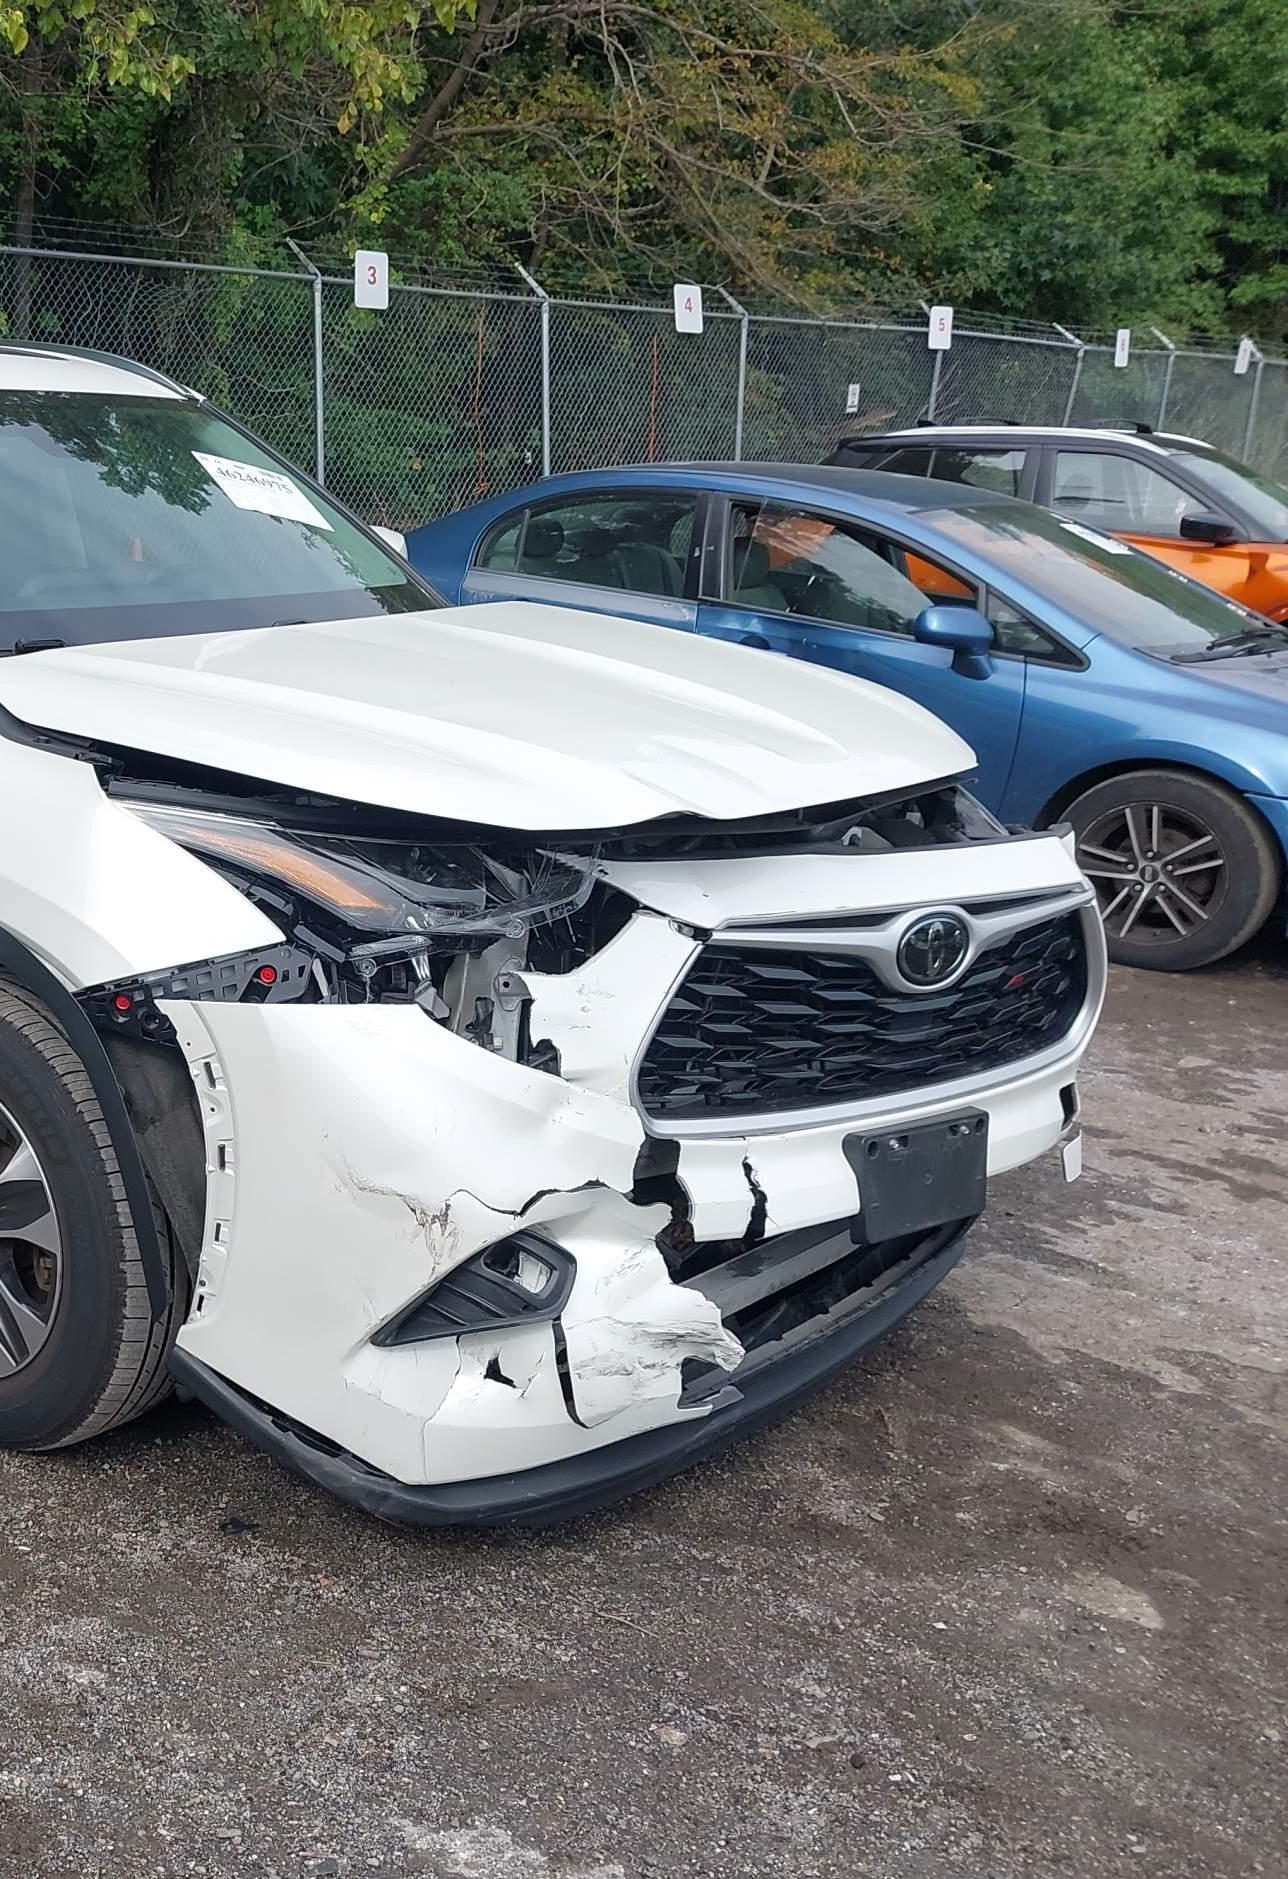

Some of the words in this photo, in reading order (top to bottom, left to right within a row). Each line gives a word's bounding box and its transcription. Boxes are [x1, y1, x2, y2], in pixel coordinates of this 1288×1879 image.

[367, 266, 377, 285] 3
[684, 297, 693, 312] 4
[938, 318, 945, 331] 5
